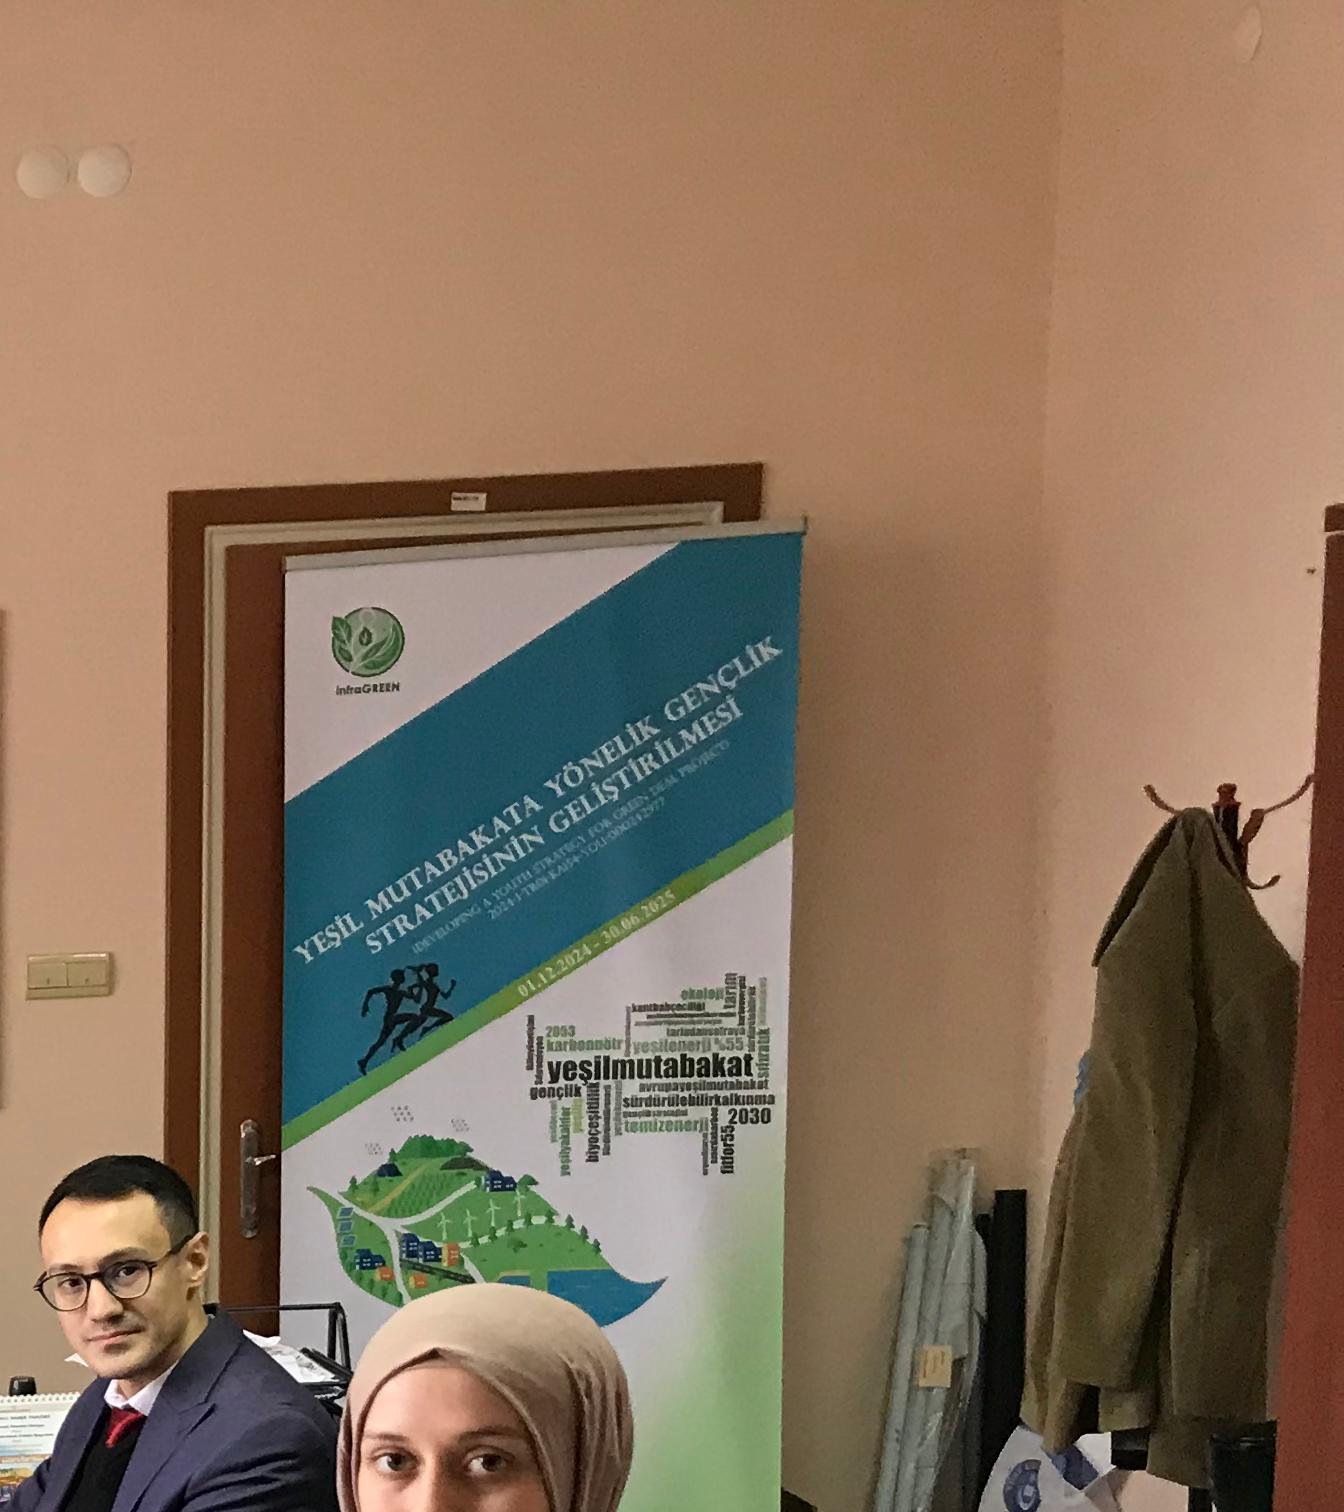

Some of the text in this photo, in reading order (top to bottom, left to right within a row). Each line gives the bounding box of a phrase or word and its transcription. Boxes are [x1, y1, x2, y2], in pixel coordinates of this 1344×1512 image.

[335, 682, 401, 695] infraGREEN
[293, 636, 783, 964] YEŞİL MUTABAKATA YÖNELİK GENÇLİK
[365, 694, 743, 955] STRATEJİSİNİN GELİŞTİRİLMESİ
[517, 942, 592, 998] 01.12.2024
[602, 889, 677, 938] 30.06.2025
[547, 1052, 754, 1086] yeşilmutabakat
[530, 1083, 582, 1101] gençlik
[728, 1107, 772, 1125] 2030
